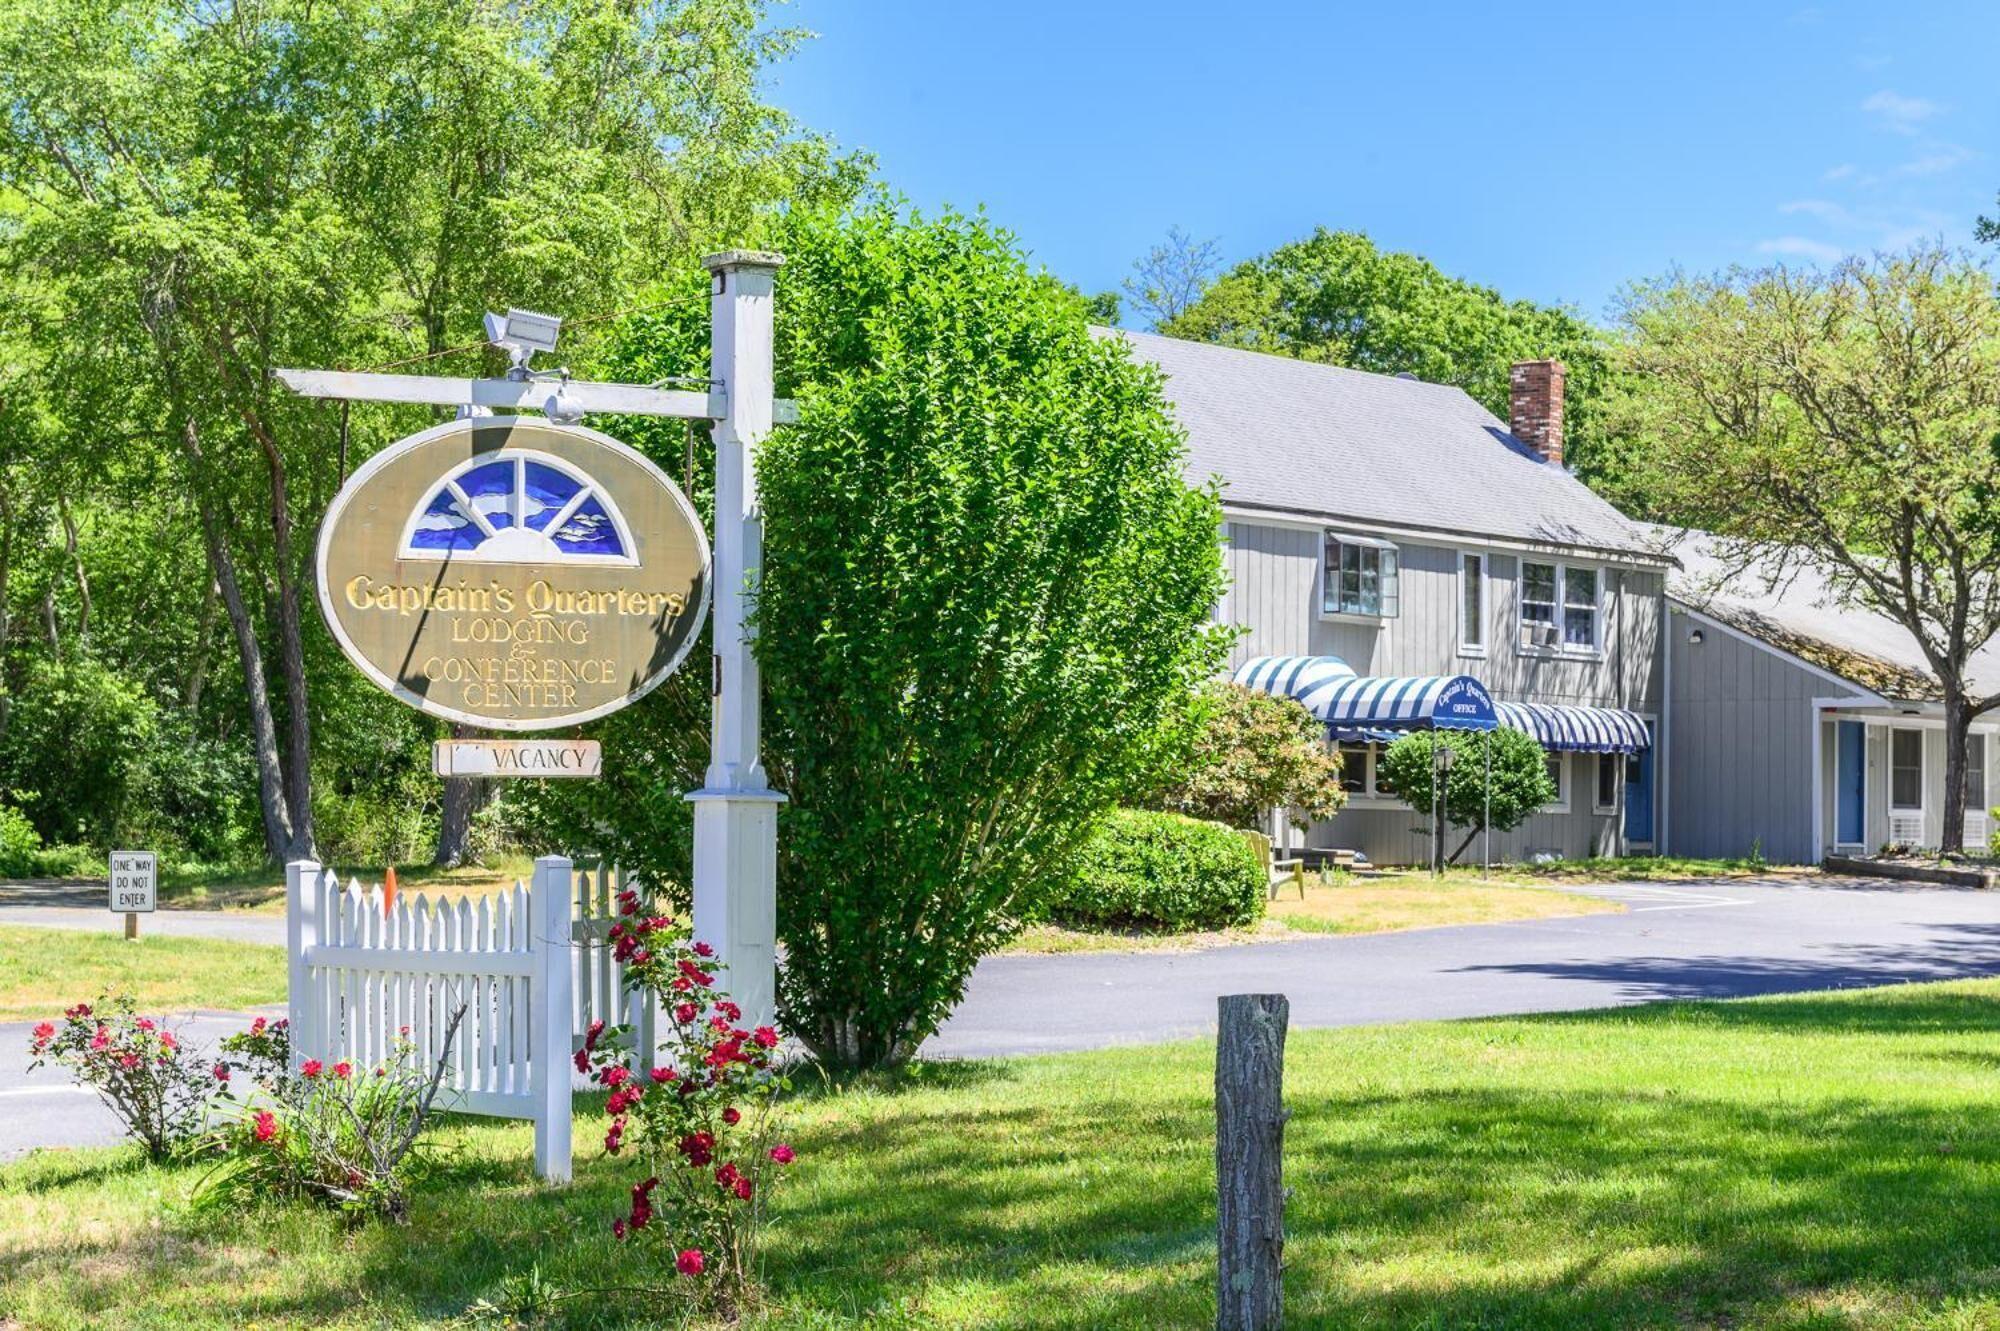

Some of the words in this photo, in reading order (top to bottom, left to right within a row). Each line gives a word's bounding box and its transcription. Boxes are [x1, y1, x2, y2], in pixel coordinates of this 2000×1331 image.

[346, 575, 514, 616] Captain's
[526, 579, 684, 618] Quarters
[451, 617, 588, 644] LODGING
[510, 642, 536, 660] &
[423, 657, 617, 684] CONFERENCE
[463, 683, 579, 707] CENTER
[1452, 703, 1477, 714] OFFICE
[492, 748, 587, 769] VACANCY
[113, 860, 132, 872] ONE
[135, 860, 152, 872] WAY
[116, 877, 129, 889] DO
[132, 877, 148, 889] NOT
[120, 893, 146, 905] ENTER
